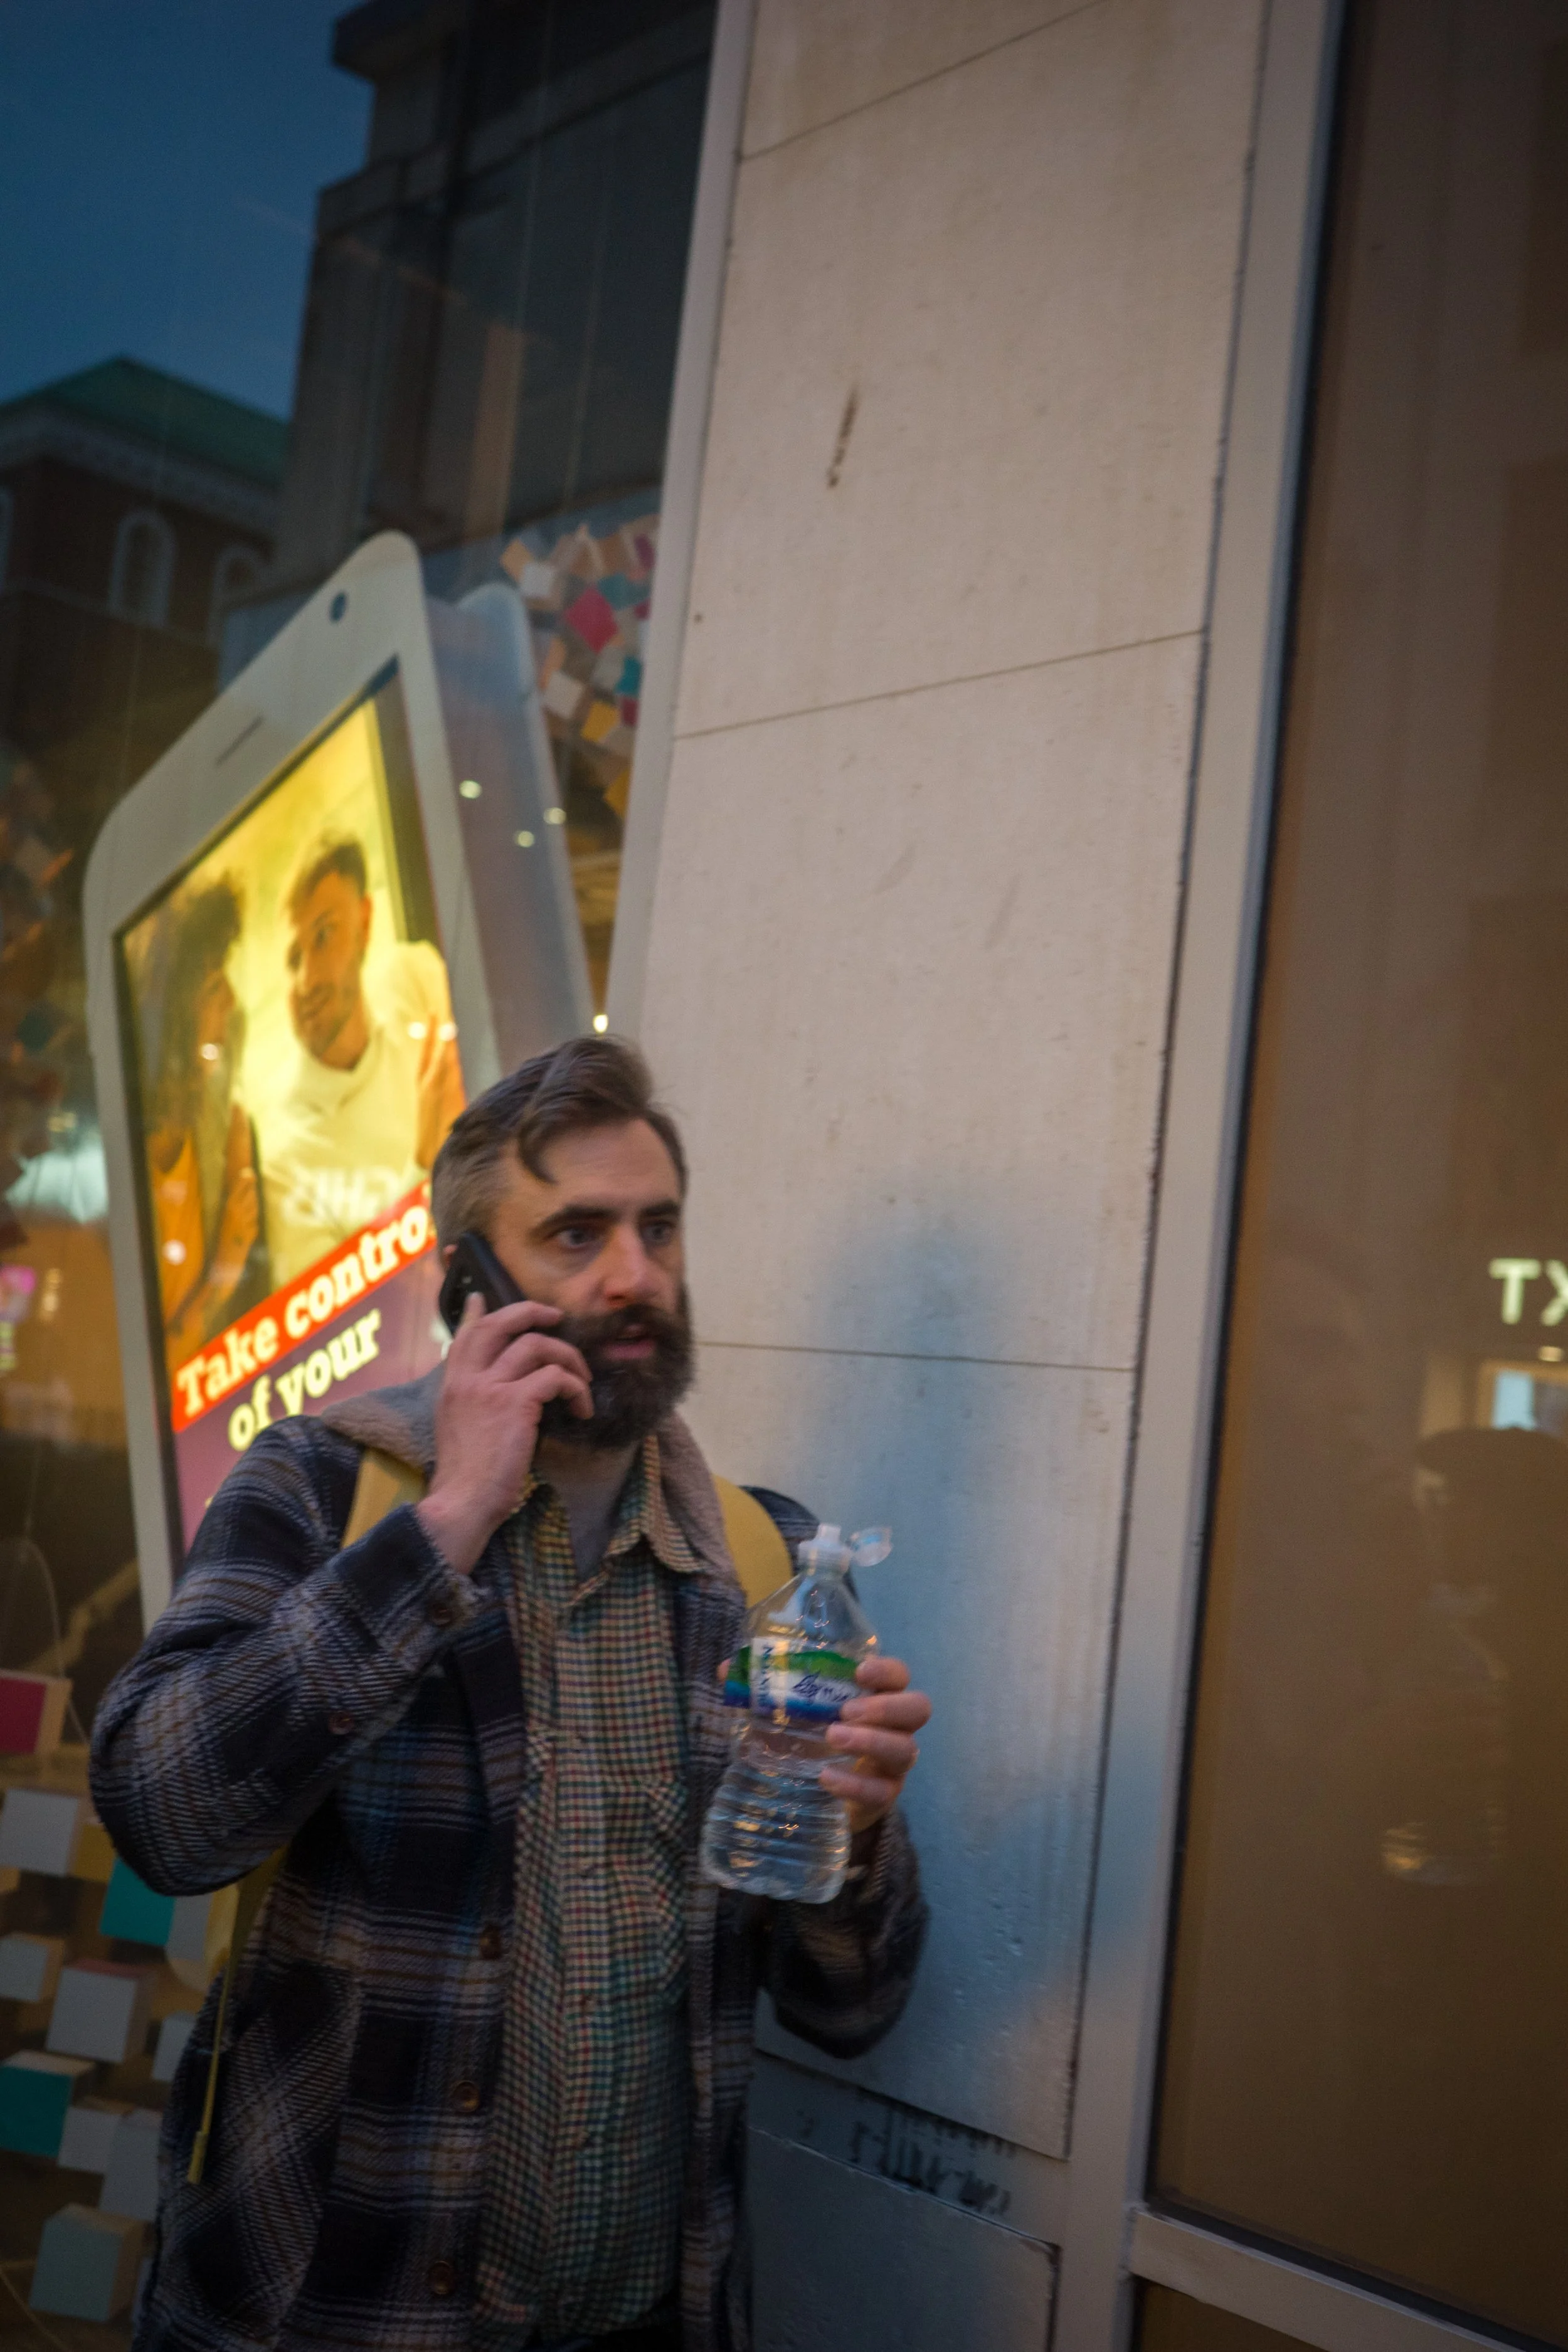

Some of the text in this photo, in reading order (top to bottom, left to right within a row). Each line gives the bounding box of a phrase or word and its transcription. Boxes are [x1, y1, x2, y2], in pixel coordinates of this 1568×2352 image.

[176, 1316, 278, 1418] Take
[285, 1187, 434, 1338] contro
[228, 1308, 382, 1451] of your
